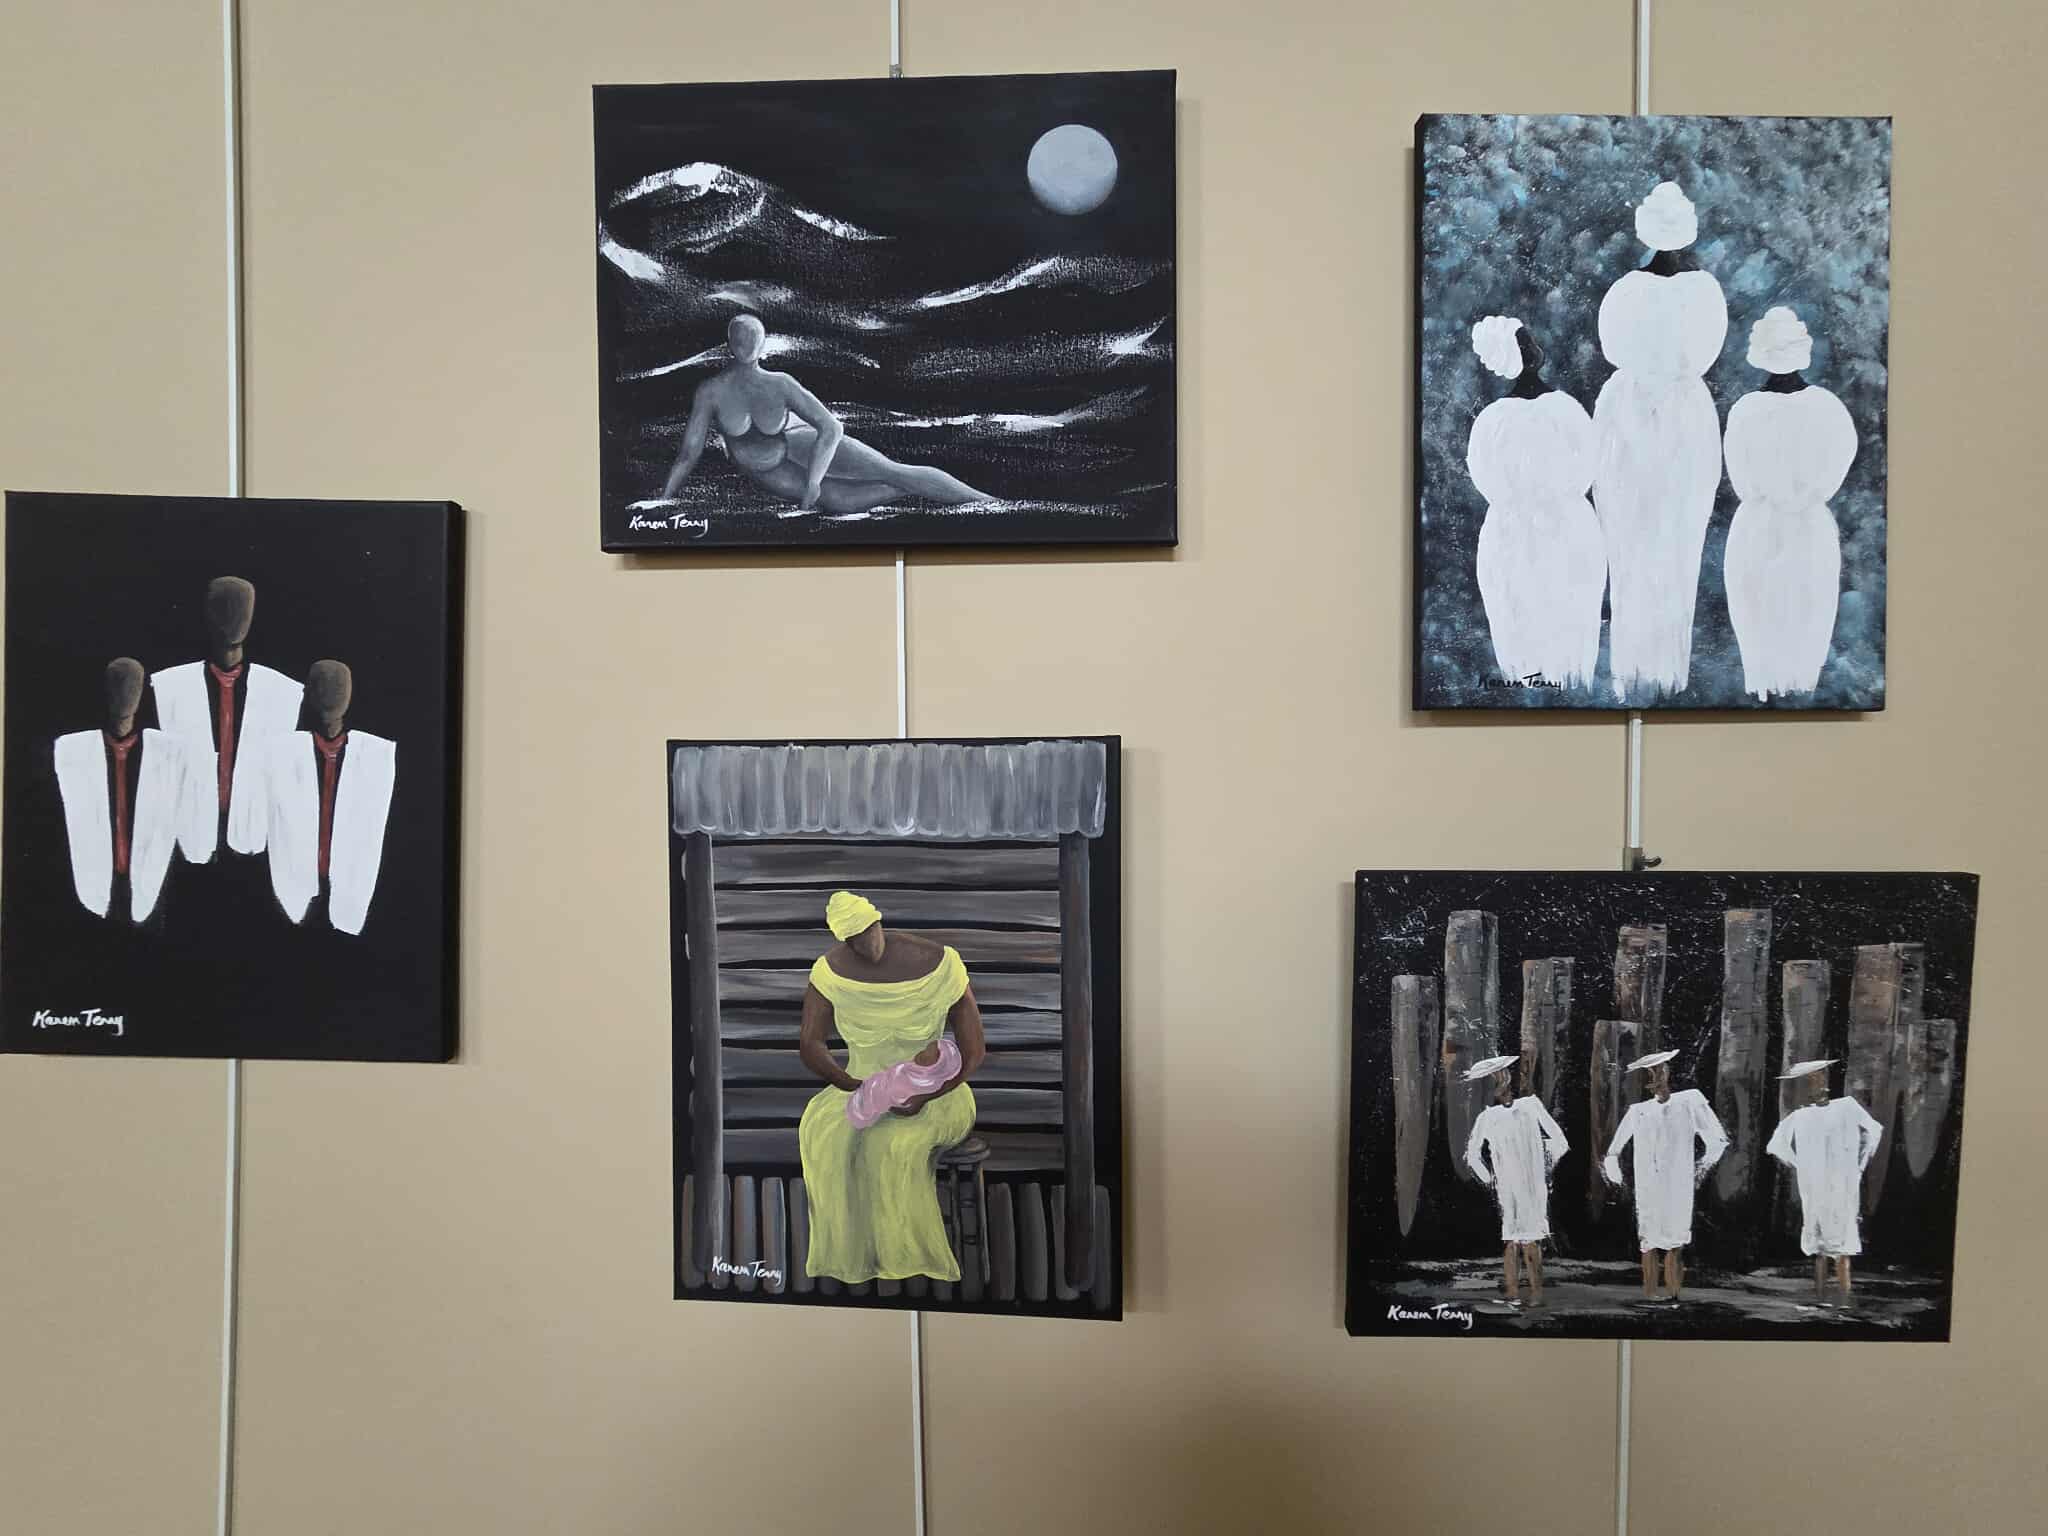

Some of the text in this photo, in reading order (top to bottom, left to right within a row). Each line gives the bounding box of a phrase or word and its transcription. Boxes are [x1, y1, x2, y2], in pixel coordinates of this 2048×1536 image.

[629, 514, 668, 531] Karen
[32, 1009, 80, 1028] Karen
[711, 1255, 750, 1276] Karen
[1387, 1305, 1432, 1321] Karen
